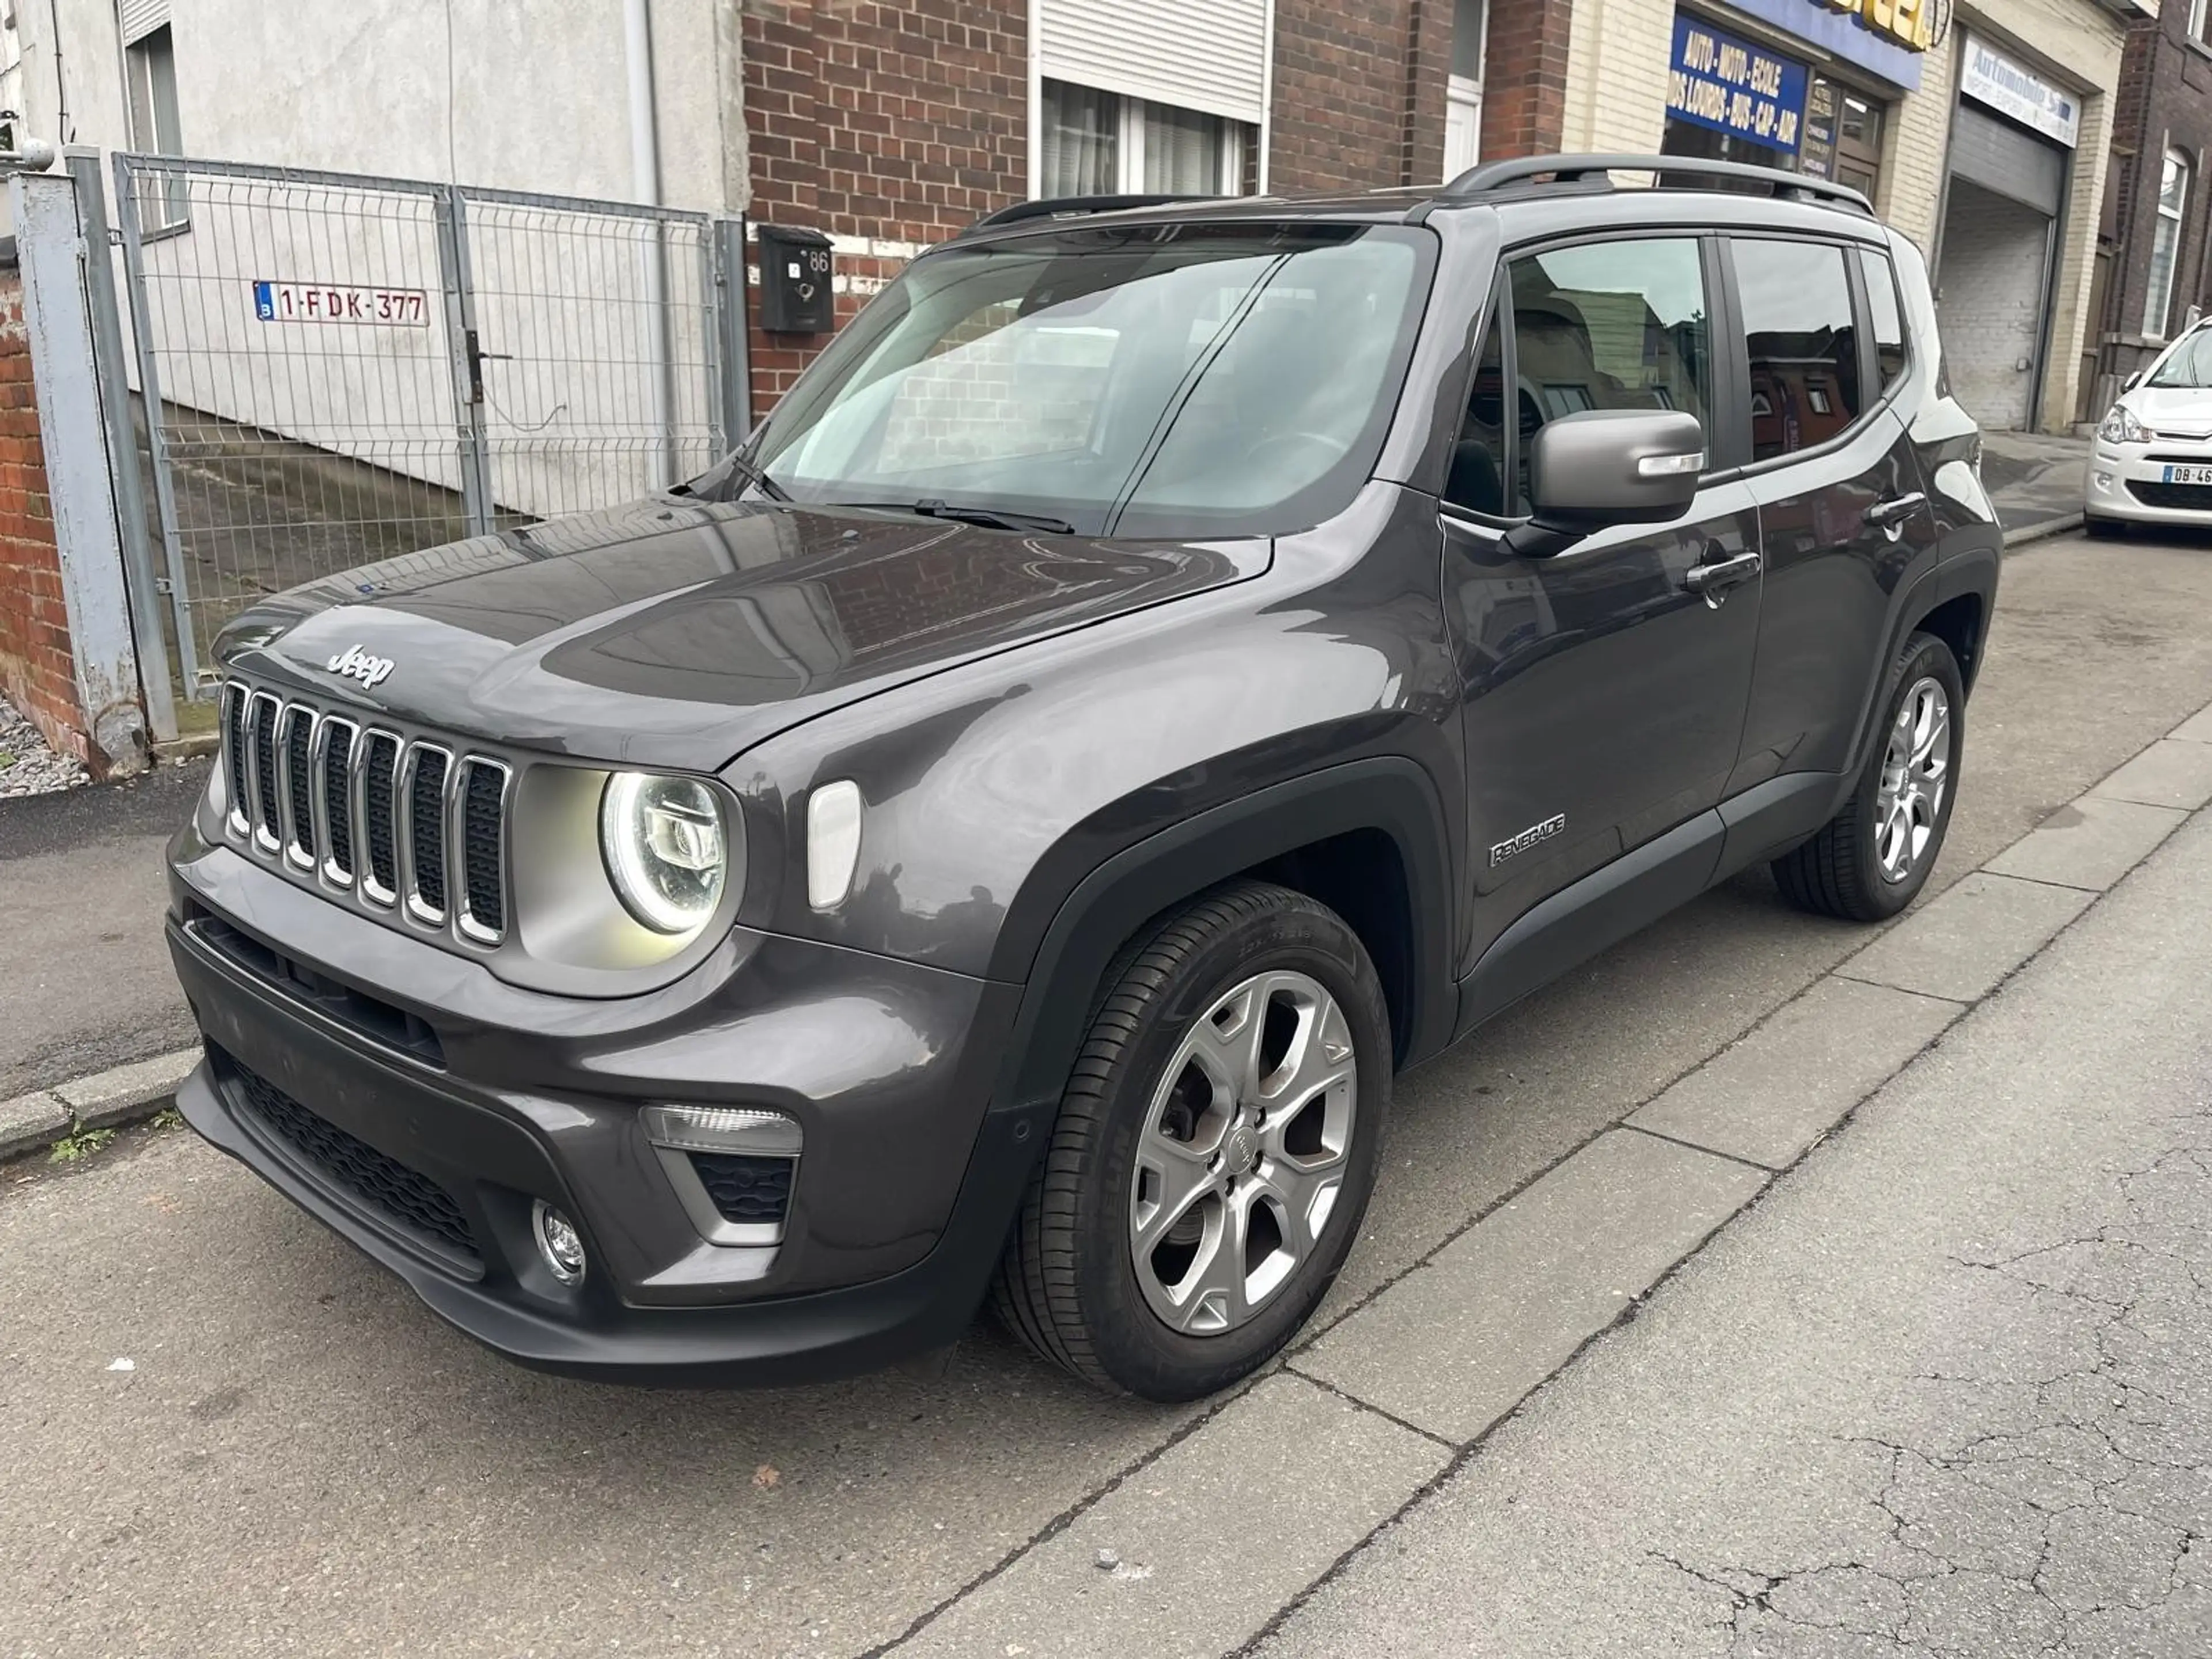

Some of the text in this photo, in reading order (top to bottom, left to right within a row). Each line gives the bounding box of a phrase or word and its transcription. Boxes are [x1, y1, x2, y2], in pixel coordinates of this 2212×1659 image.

[1683, 31, 1782, 99] AUTO MOTO ECOLE
[1685, 76, 1727, 123] LOURDS
[1730, 92, 1752, 131] BUS
[1755, 101, 1775, 138] CAP
[810, 251, 828, 272] 86
[281, 290, 421, 320] 1-FDK-377
[327, 644, 396, 690] Jeep
[1488, 813, 1565, 868] RENEGADE
